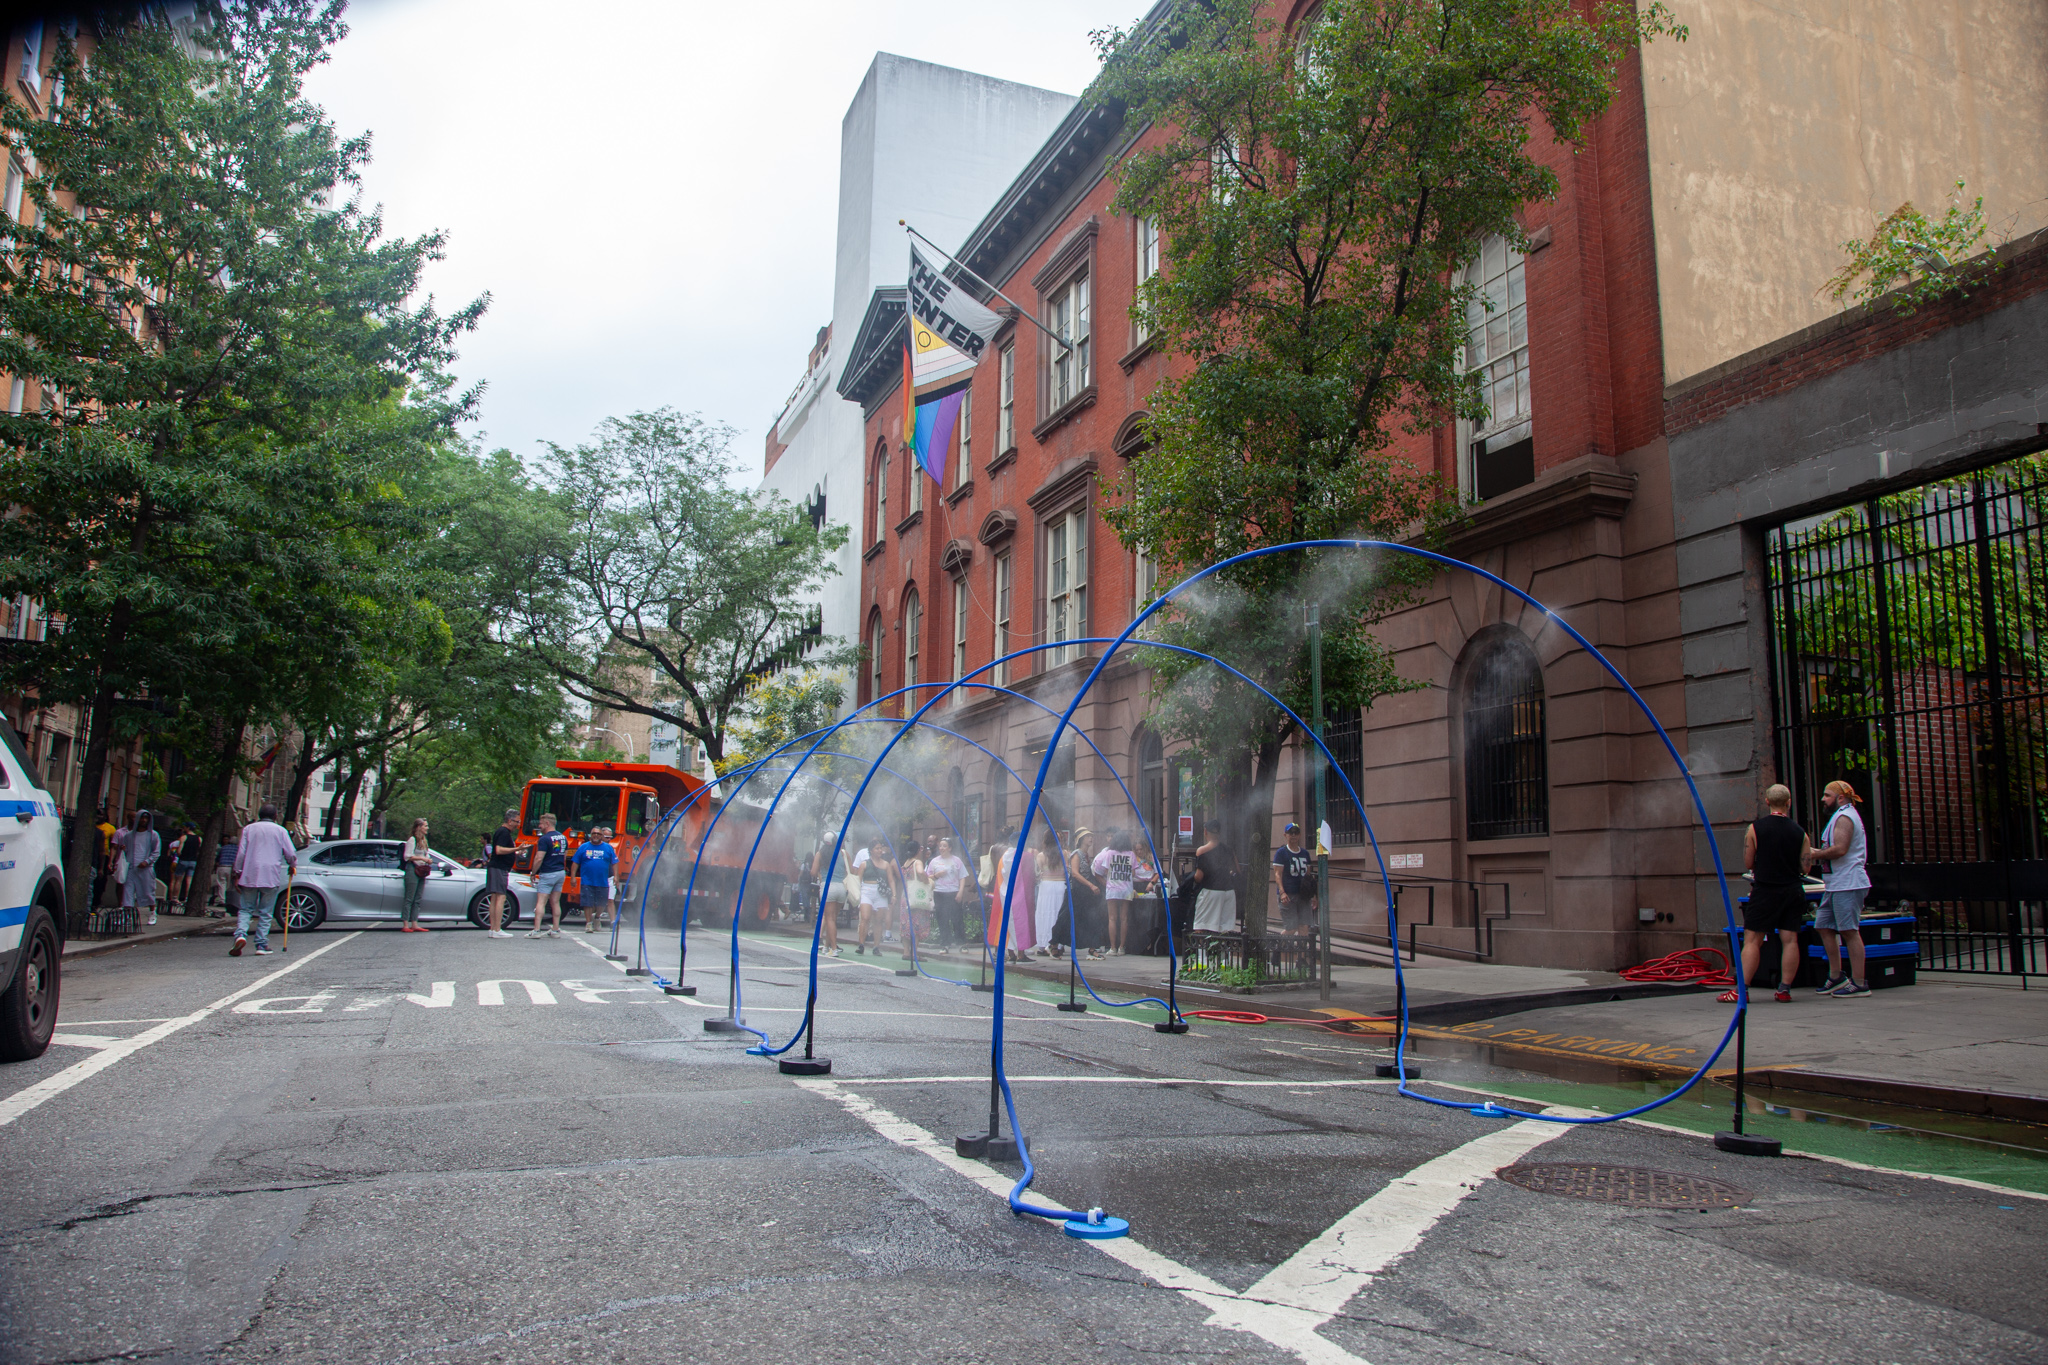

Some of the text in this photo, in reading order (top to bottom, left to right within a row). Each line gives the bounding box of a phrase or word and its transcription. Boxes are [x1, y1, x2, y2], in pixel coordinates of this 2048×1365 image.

[1112, 854, 1130, 864] LIVE
[1110, 863, 1132, 873] YOUR
[1110, 871, 1131, 881] LOOK
[1489, 1028, 1696, 1060] PARKING
